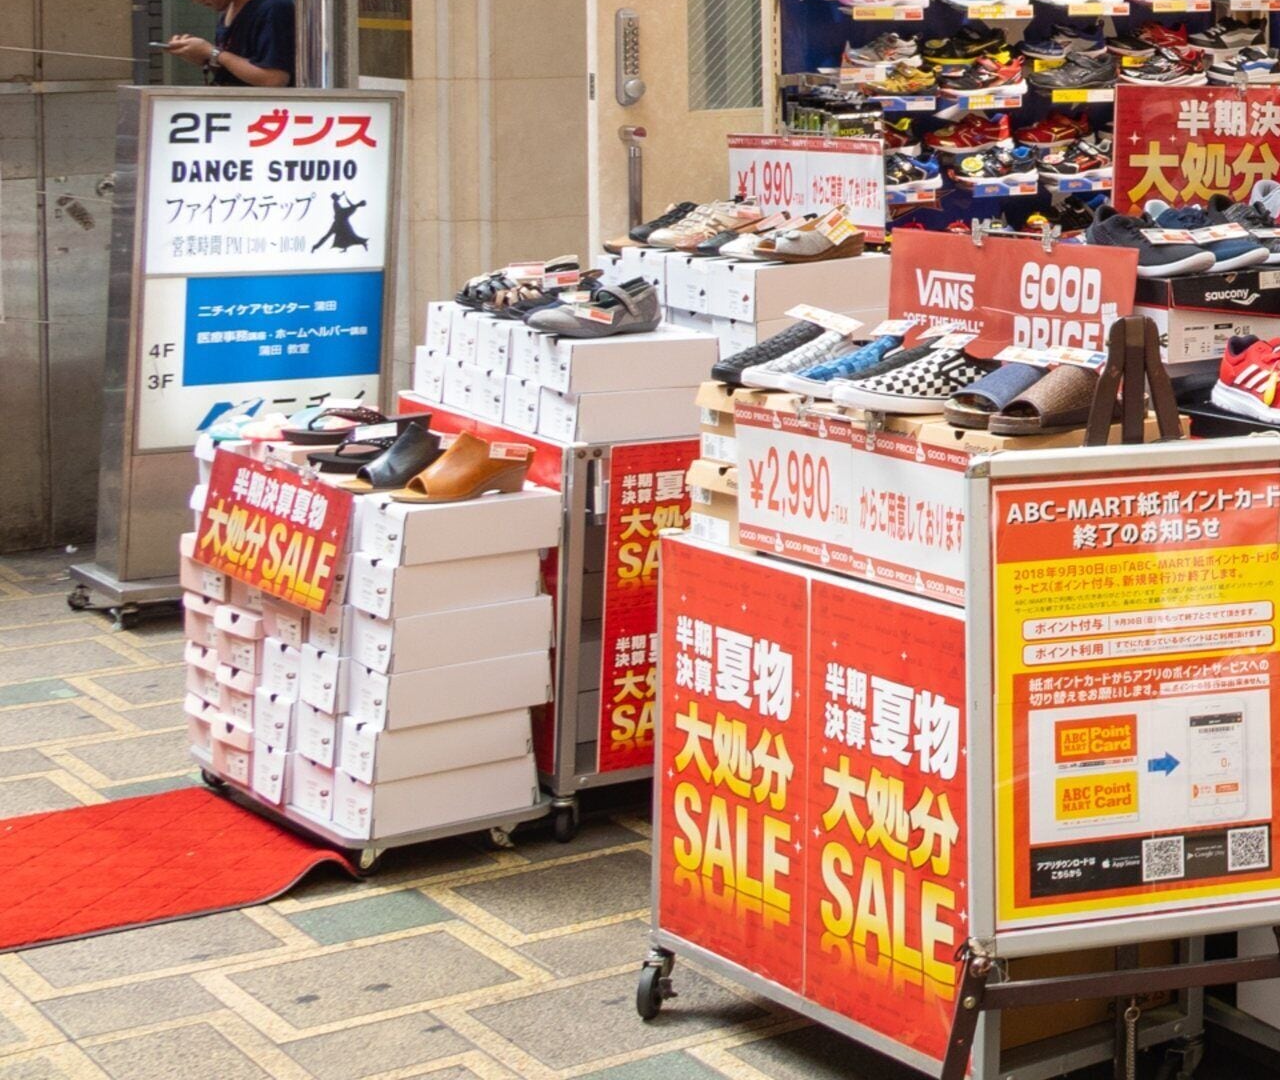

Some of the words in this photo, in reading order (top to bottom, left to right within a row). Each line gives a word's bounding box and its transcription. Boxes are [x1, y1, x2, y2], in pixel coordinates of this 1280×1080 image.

[169, 112, 232, 144] 2F
[247, 108, 377, 148] ダンス
[171, 159, 253, 184] DANCE
[268, 159, 358, 182] STUDIO
[166, 192, 317, 224] ファイブステップ
[172, 235, 223, 258] 営業時間
[914, 267, 977, 312] VANS
[1020, 261, 1102, 315] GOOD
[1204, 288, 1250, 303] saucony
[197, 302, 310, 318] ニチイケアセンター
[149, 343, 176, 359] 4F
[147, 373, 175, 390] 3F
[621, 472, 653, 490] 半期
[621, 489, 653, 505] 決算
[748, 445, 831, 524] ¥2,990
[232, 467, 329, 531] 半期決算夏物
[1072, 517, 1221, 550] 終了のお知らせ
[676, 615, 712, 661] 半期
[1034, 619, 1103, 635] ポイント付与
[1034, 643, 1104, 659] ポイント利用
[675, 650, 713, 696] 決算
[715, 626, 793, 722] 夏物
[825, 662, 867, 711] 半期
[825, 704, 866, 751] 決算
[870, 681, 960, 780] 夏物
[1090, 724, 1131, 740] Point
[675, 702, 794, 810] 大処分
[1090, 736, 1131, 753] Card
[1062, 786, 1091, 801] ABC
[1094, 782, 1131, 797] Point
[1094, 793, 1132, 809] Card
[822, 757, 960, 877] 大処分
[673, 782, 792, 912] SALE
[820, 843, 957, 987] SALE
